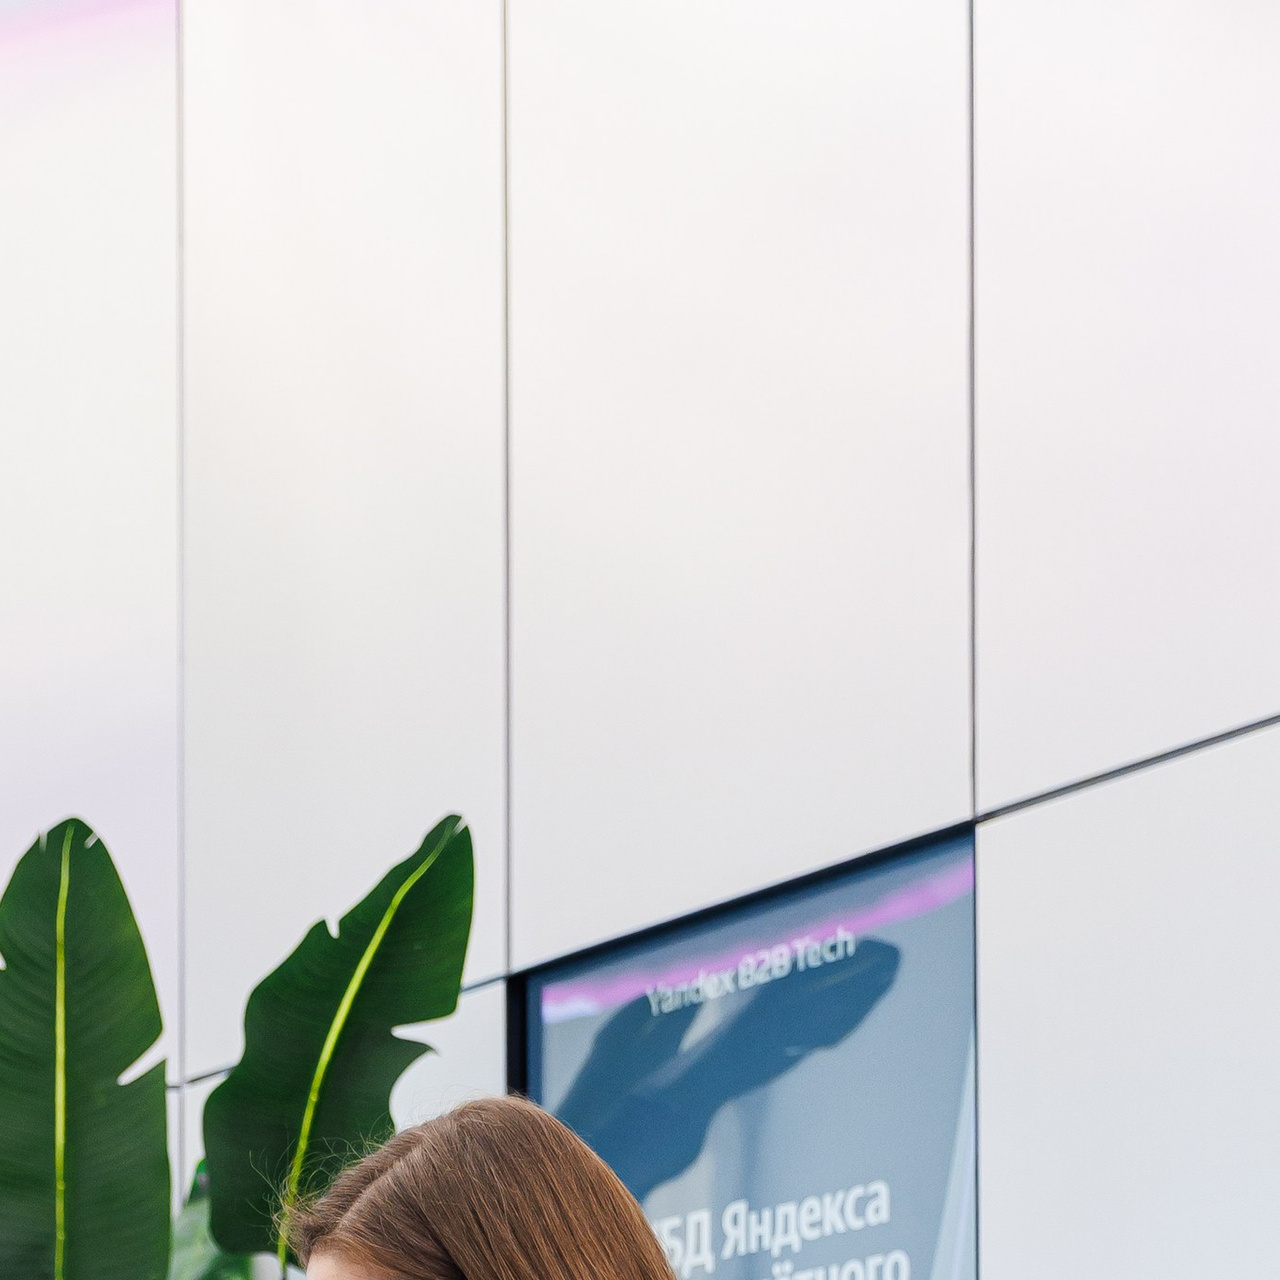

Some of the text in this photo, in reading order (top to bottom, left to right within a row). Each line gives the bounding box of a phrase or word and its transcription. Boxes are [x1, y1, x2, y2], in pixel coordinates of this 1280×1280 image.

[644, 924, 857, 1018] Yandex B2B Tech
[656, 1179, 892, 1280] БД Яндекса
